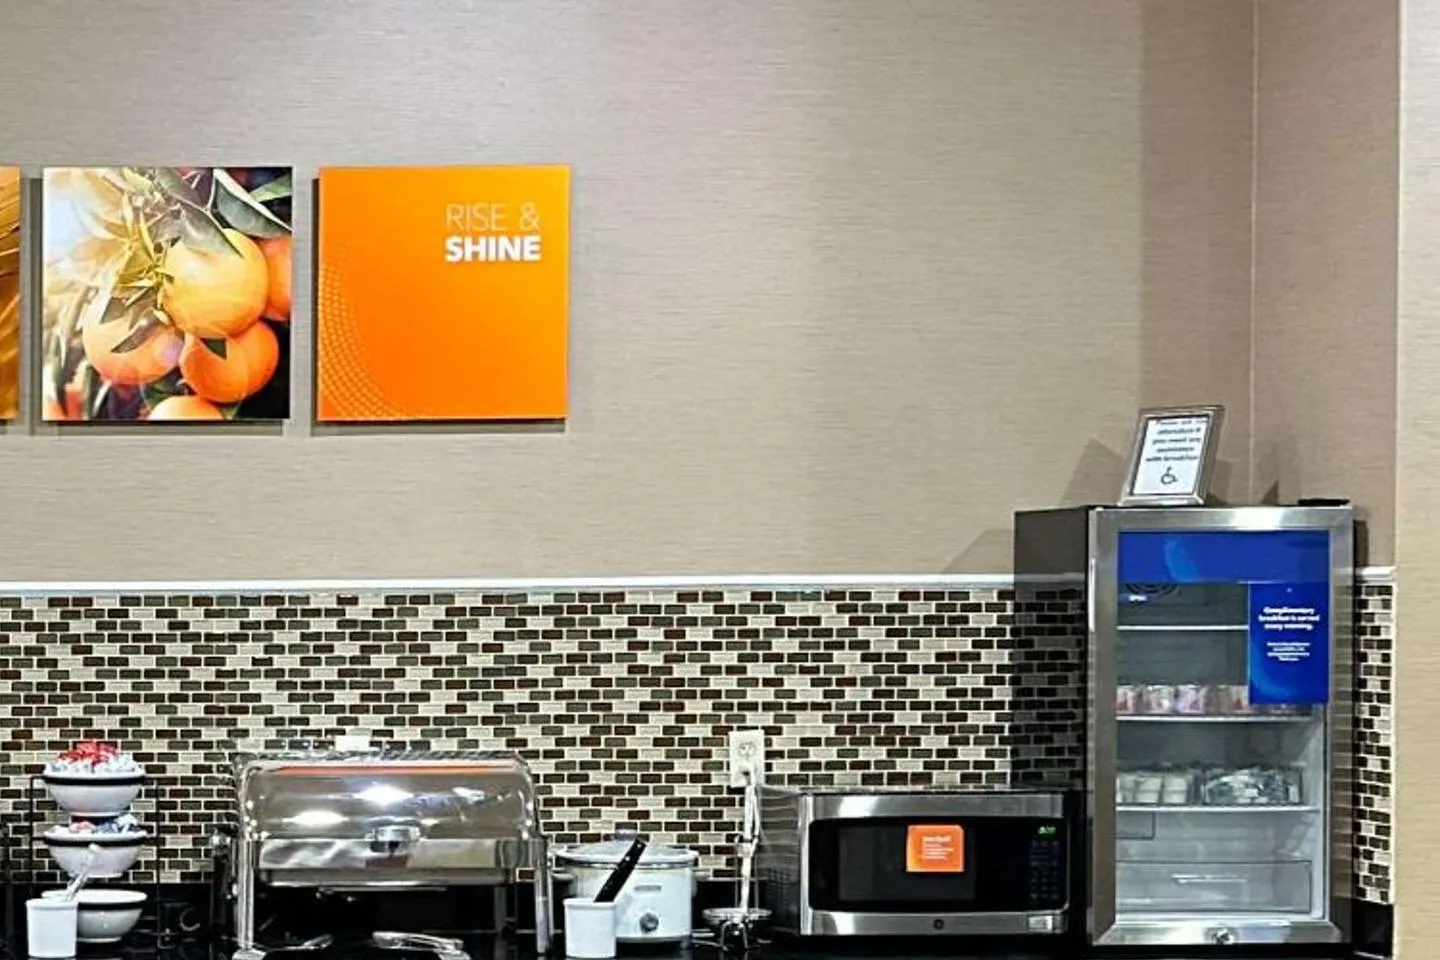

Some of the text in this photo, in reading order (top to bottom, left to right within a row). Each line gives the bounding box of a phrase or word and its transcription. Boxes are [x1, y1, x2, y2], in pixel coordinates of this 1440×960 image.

[446, 201, 540, 232] RISE &
[444, 235, 542, 262] SHINE
